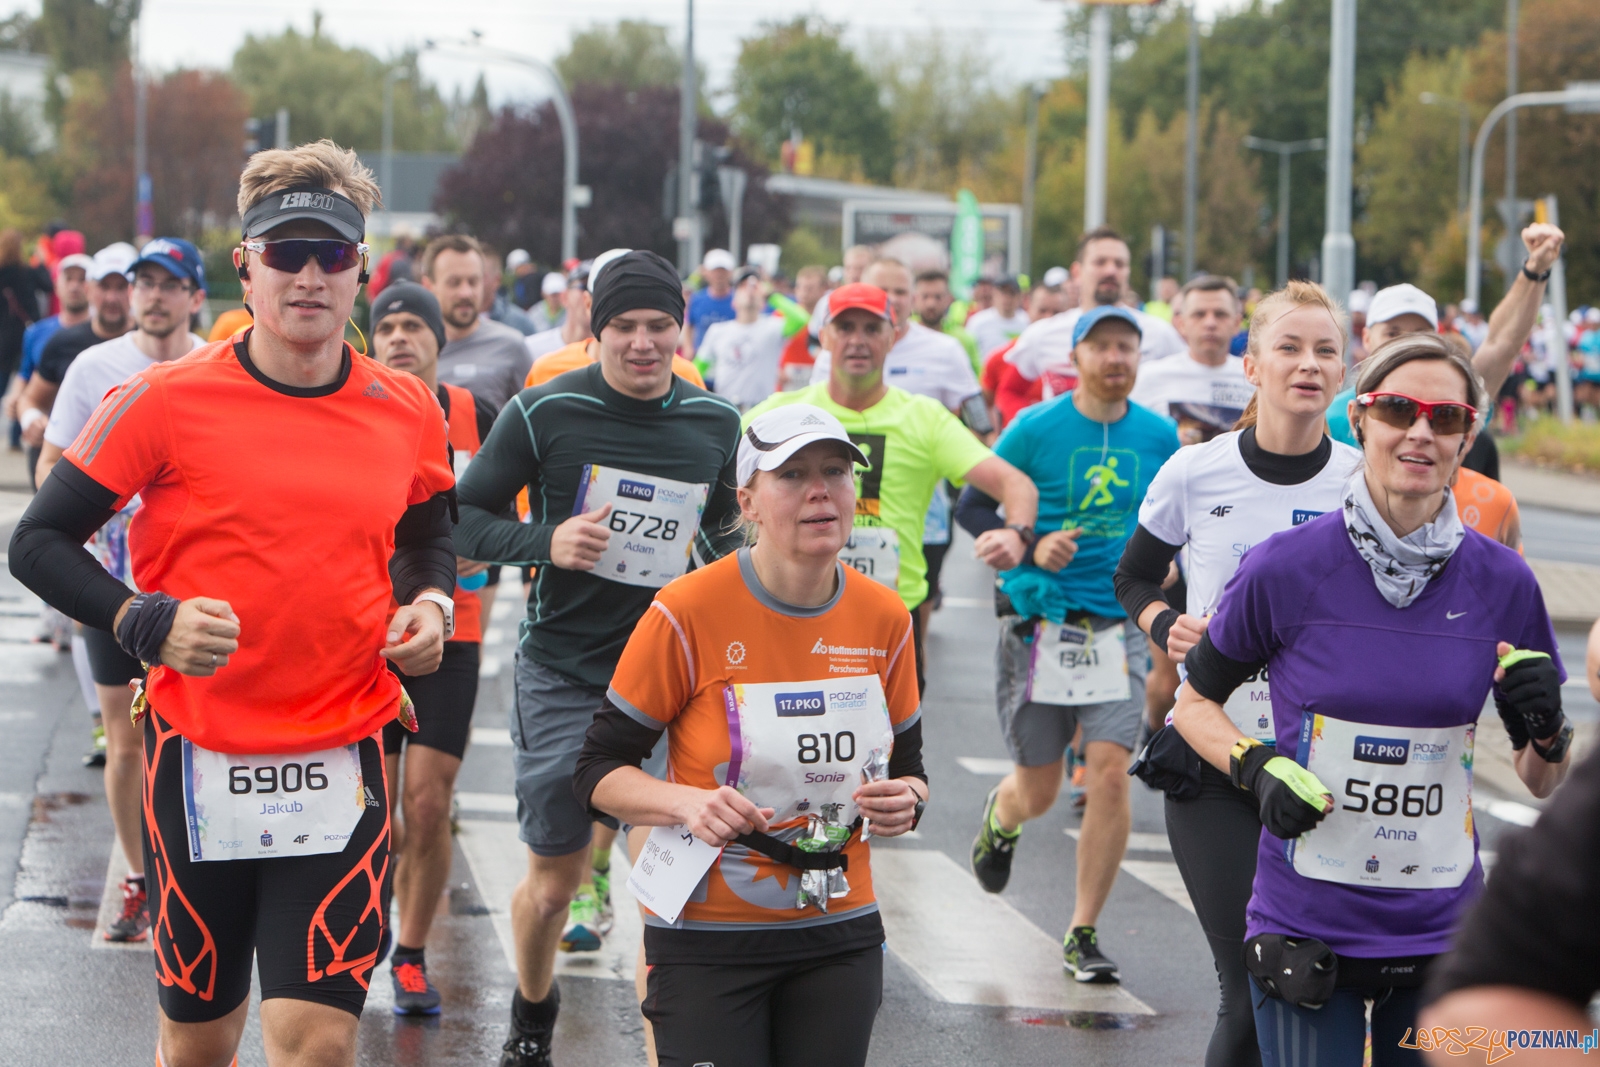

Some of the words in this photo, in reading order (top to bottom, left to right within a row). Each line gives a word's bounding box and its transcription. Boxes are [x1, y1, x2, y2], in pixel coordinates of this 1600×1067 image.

[1210, 505, 1233, 517] 4F
[609, 509, 679, 541] 6728
[623, 541, 655, 555] Adam
[828, 645, 868, 656] Hoffmann
[828, 664, 868, 674] Perschmann
[830, 700, 867, 709] maraton
[797, 731, 856, 764] 810
[228, 762, 329, 795] 6906
[804, 772, 845, 784] Sonia
[1342, 778, 1443, 818] 5860
[259, 801, 304, 815] Jakub
[293, 834, 310, 844] 4F
[1374, 826, 1418, 842] Anna
[660, 849, 675, 866] dla
[1400, 865, 1419, 874] 4F
